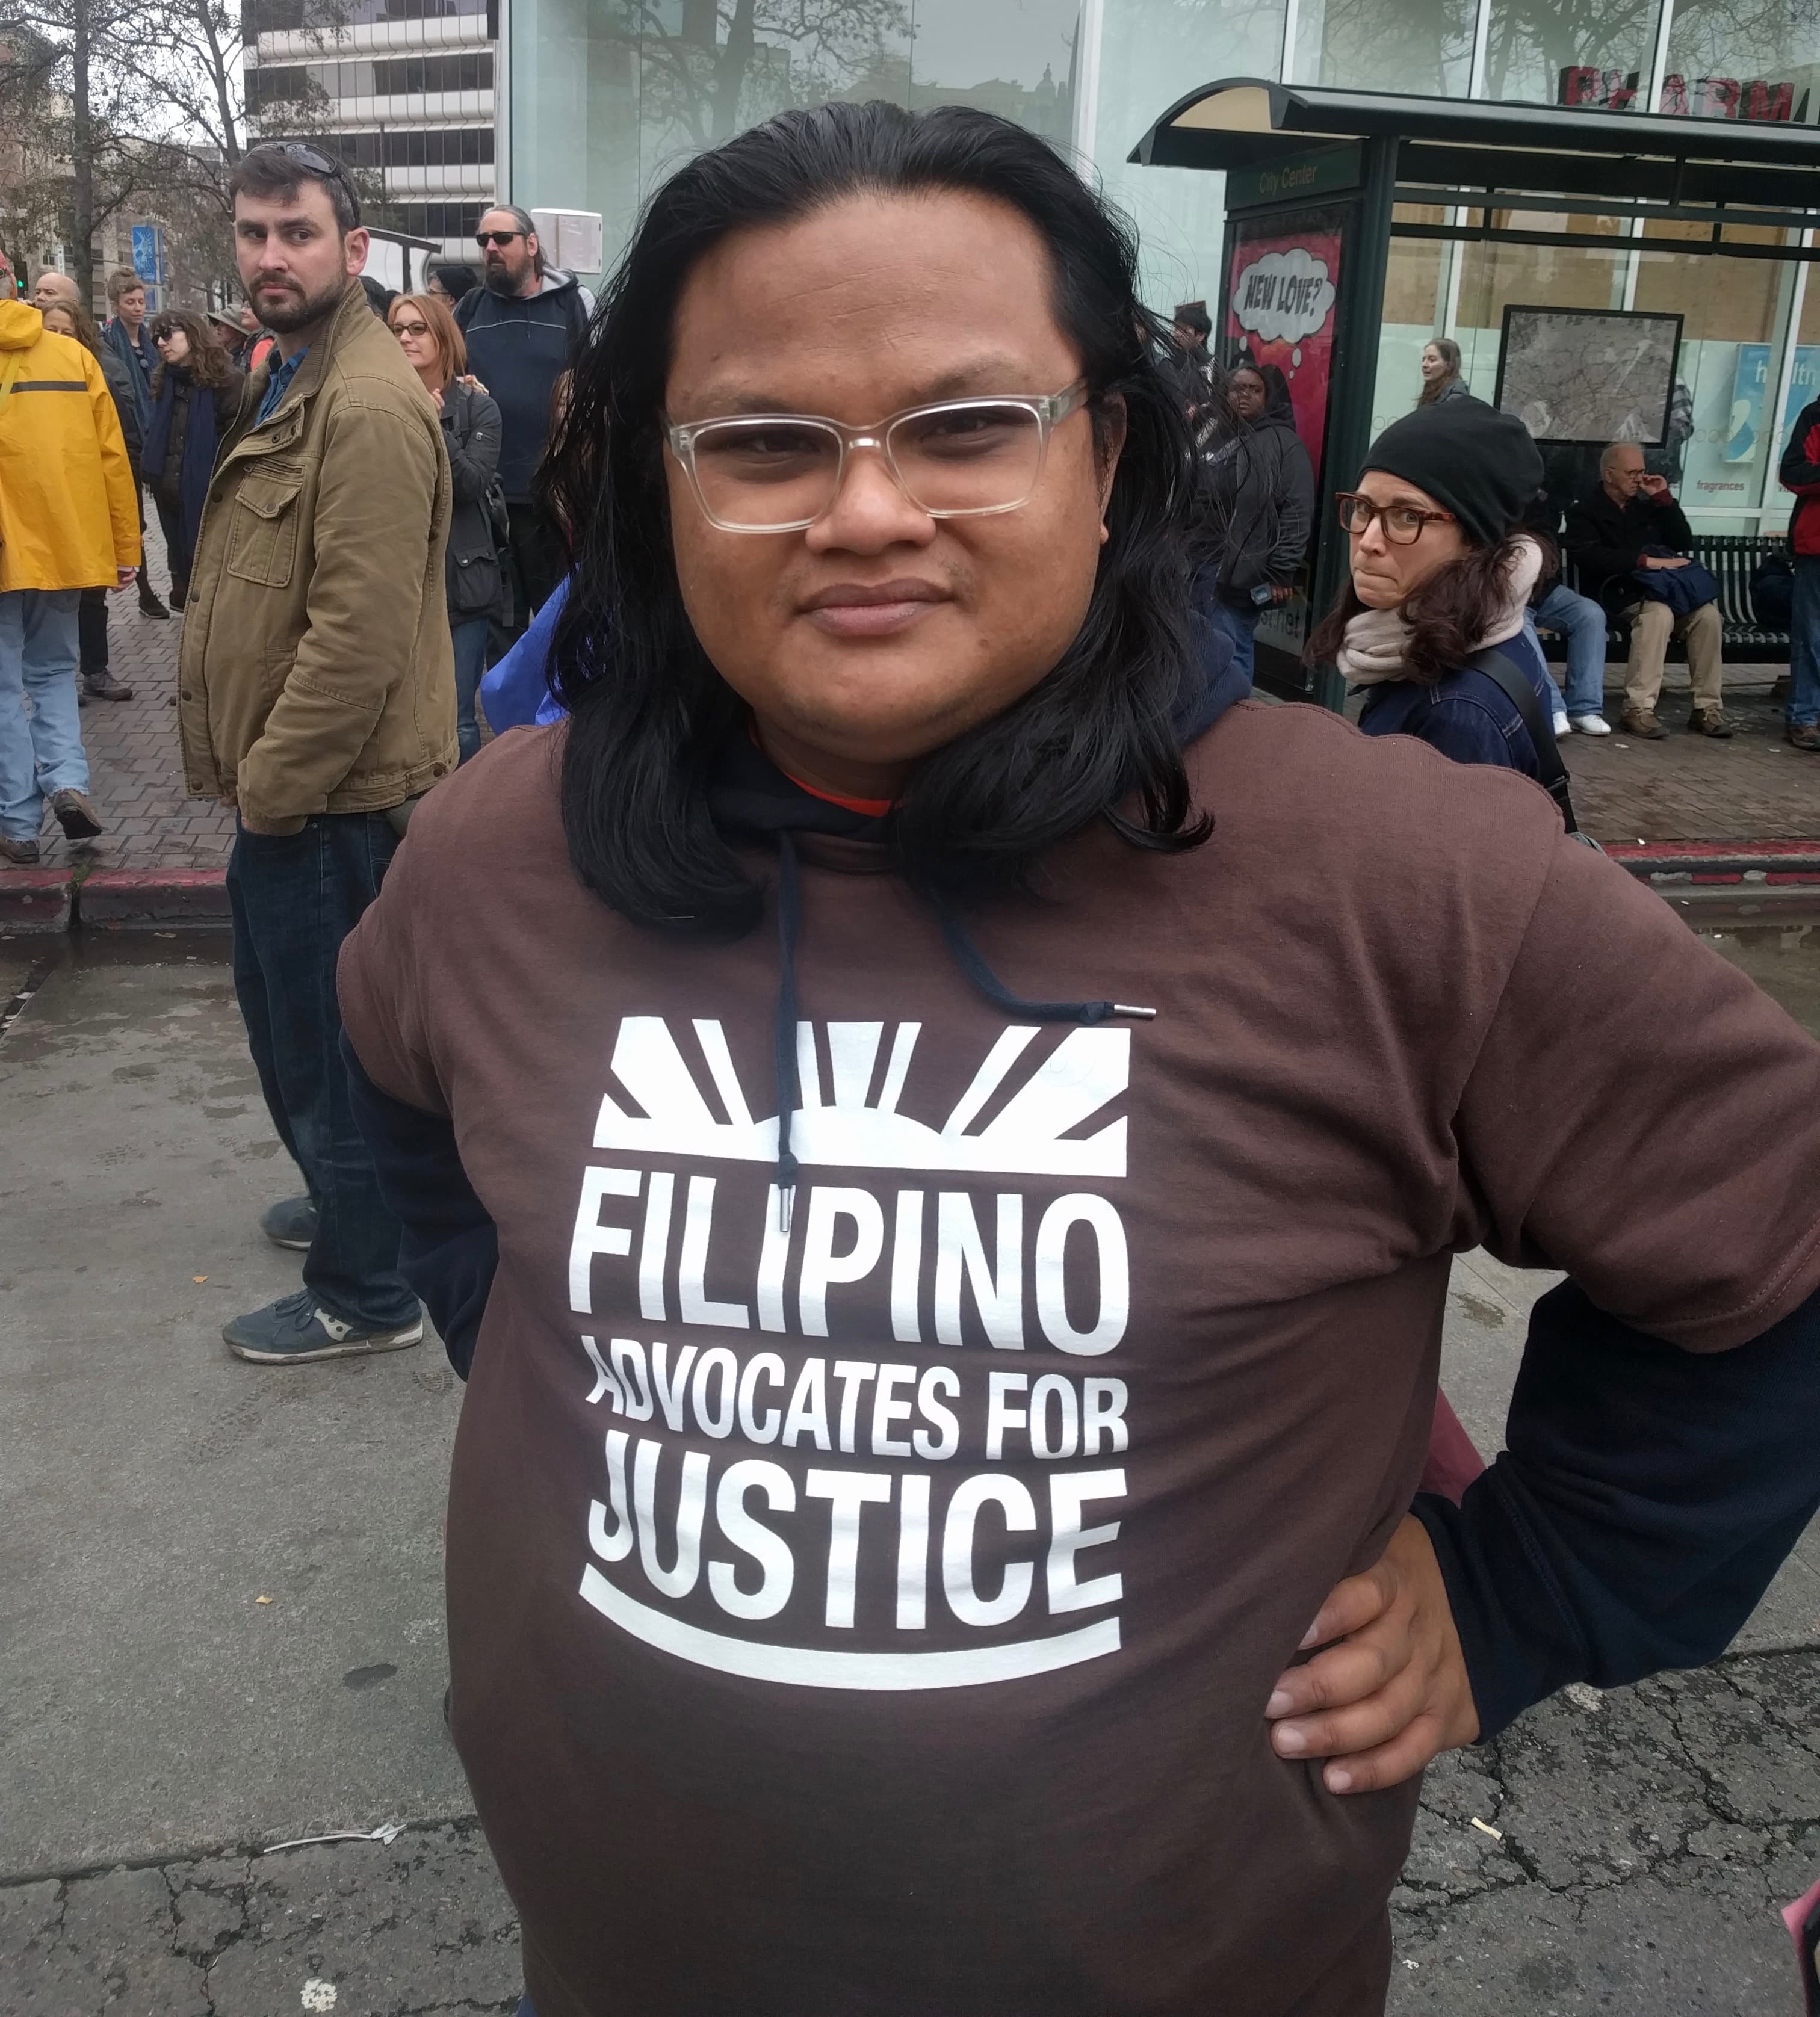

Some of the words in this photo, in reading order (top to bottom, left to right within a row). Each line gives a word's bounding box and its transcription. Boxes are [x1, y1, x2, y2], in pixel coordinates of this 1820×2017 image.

[1260, 171, 1280, 196] City
[1281, 164, 1319, 188] Center
[1243, 274, 1277, 311] NEW
[1277, 275, 1323, 317] LOVE?
[1696, 480, 1745, 493] fragrances
[569, 1166, 1130, 1356] FILIPINO
[586, 1335, 961, 1460] ADVOCATES
[985, 1371, 1129, 1460] FOR
[587, 1429, 1127, 1629] JUSTICE
